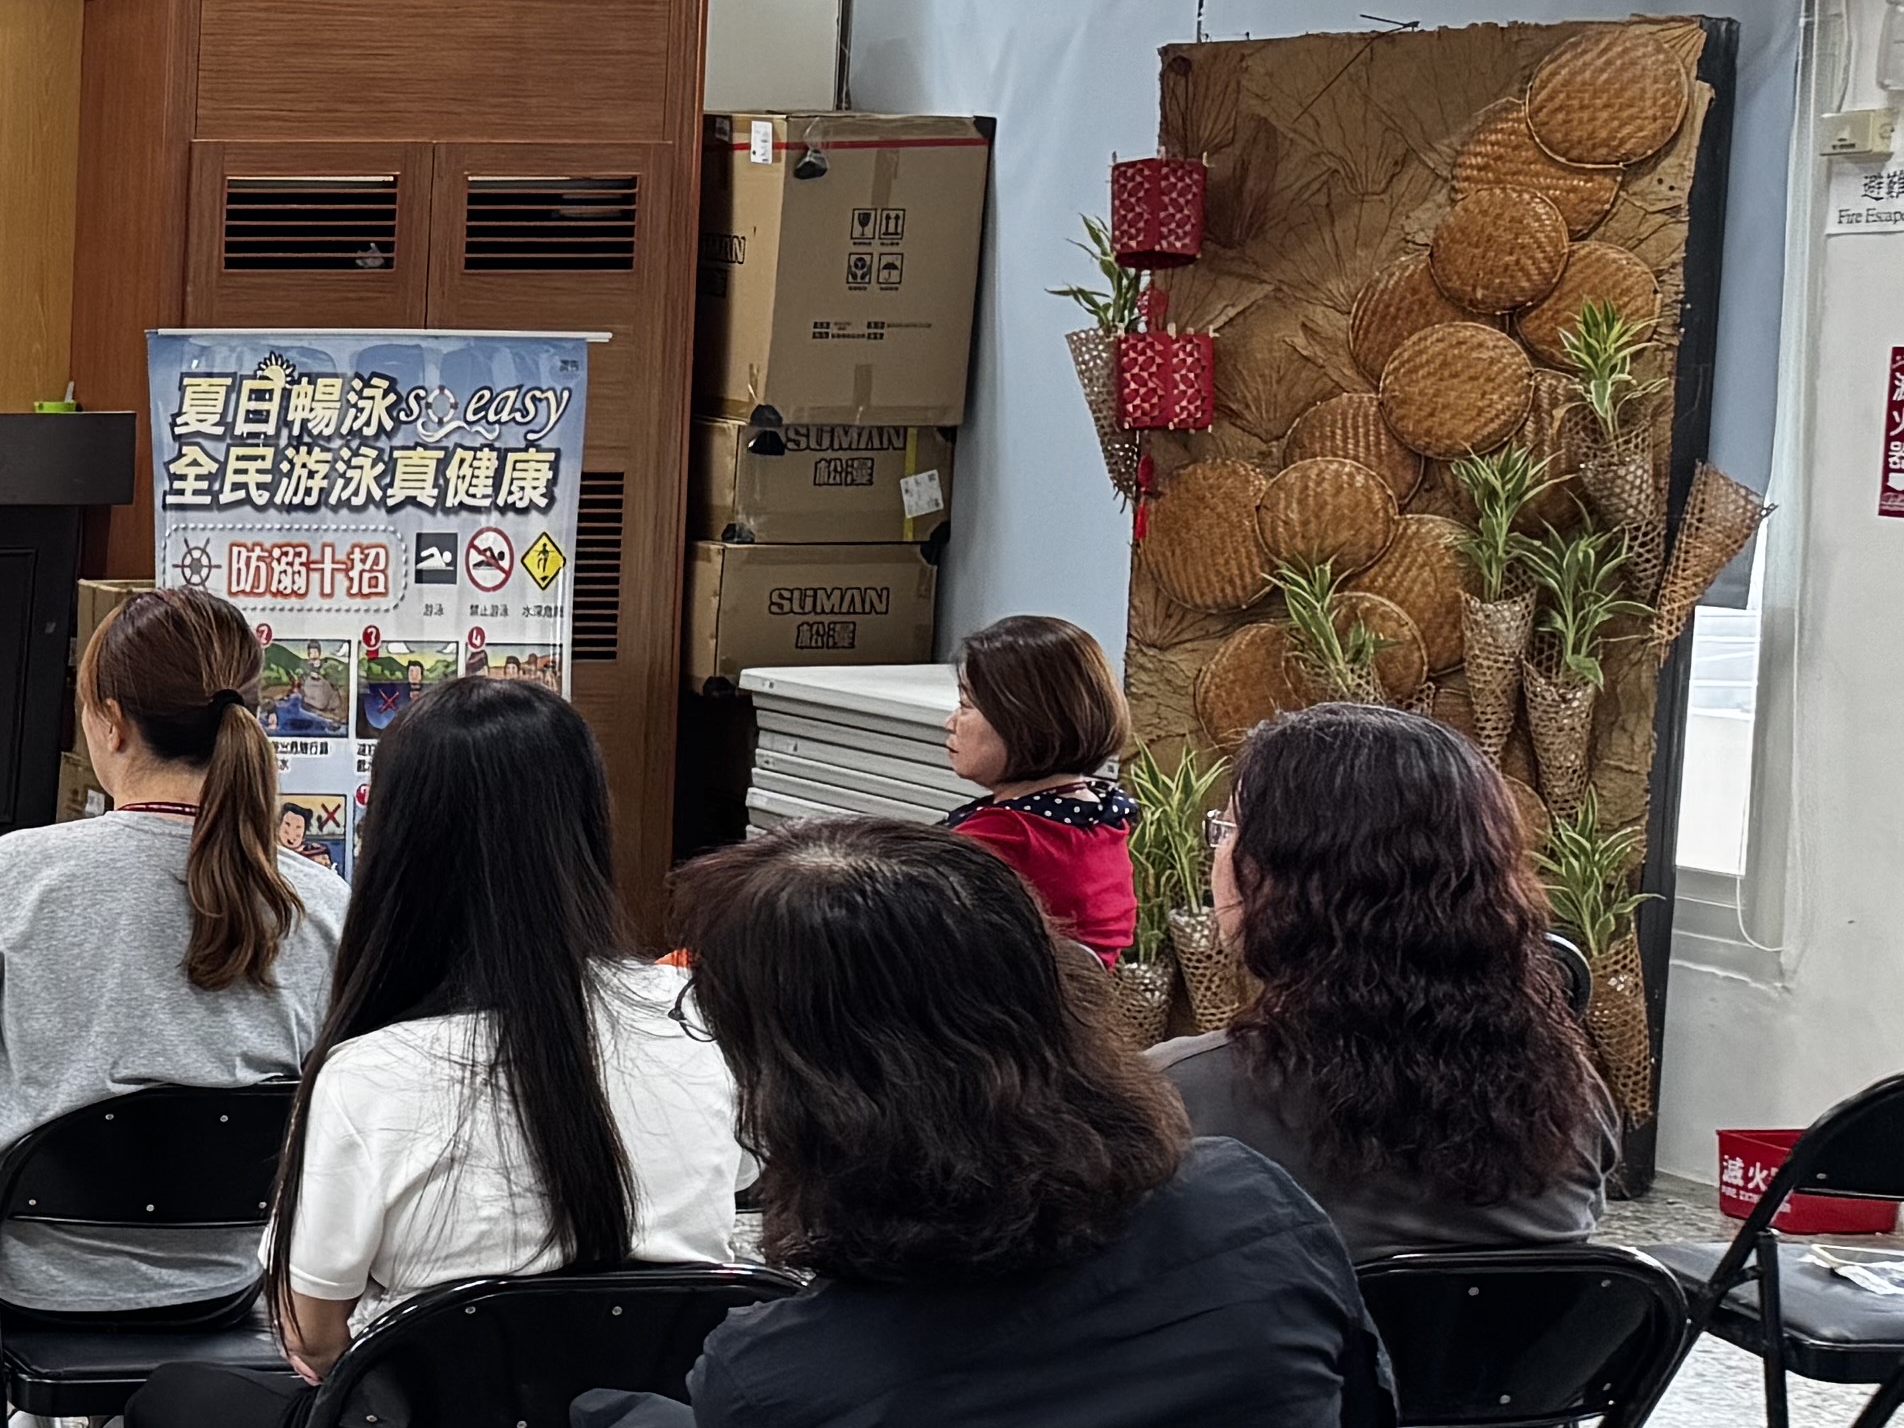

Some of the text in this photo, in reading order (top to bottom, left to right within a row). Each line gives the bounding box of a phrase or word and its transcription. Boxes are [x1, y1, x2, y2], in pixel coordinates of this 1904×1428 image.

[1838, 208, 1863, 225] Fire
[173, 376, 398, 438] 夏日暢泳
[464, 384, 571, 442] easy
[165, 445, 557, 509] 全民游泳真健康
[227, 544, 389, 598] 防溺十招
[768, 587, 890, 616] SUMAN
[1722, 1154, 1780, 1192] 滅火
